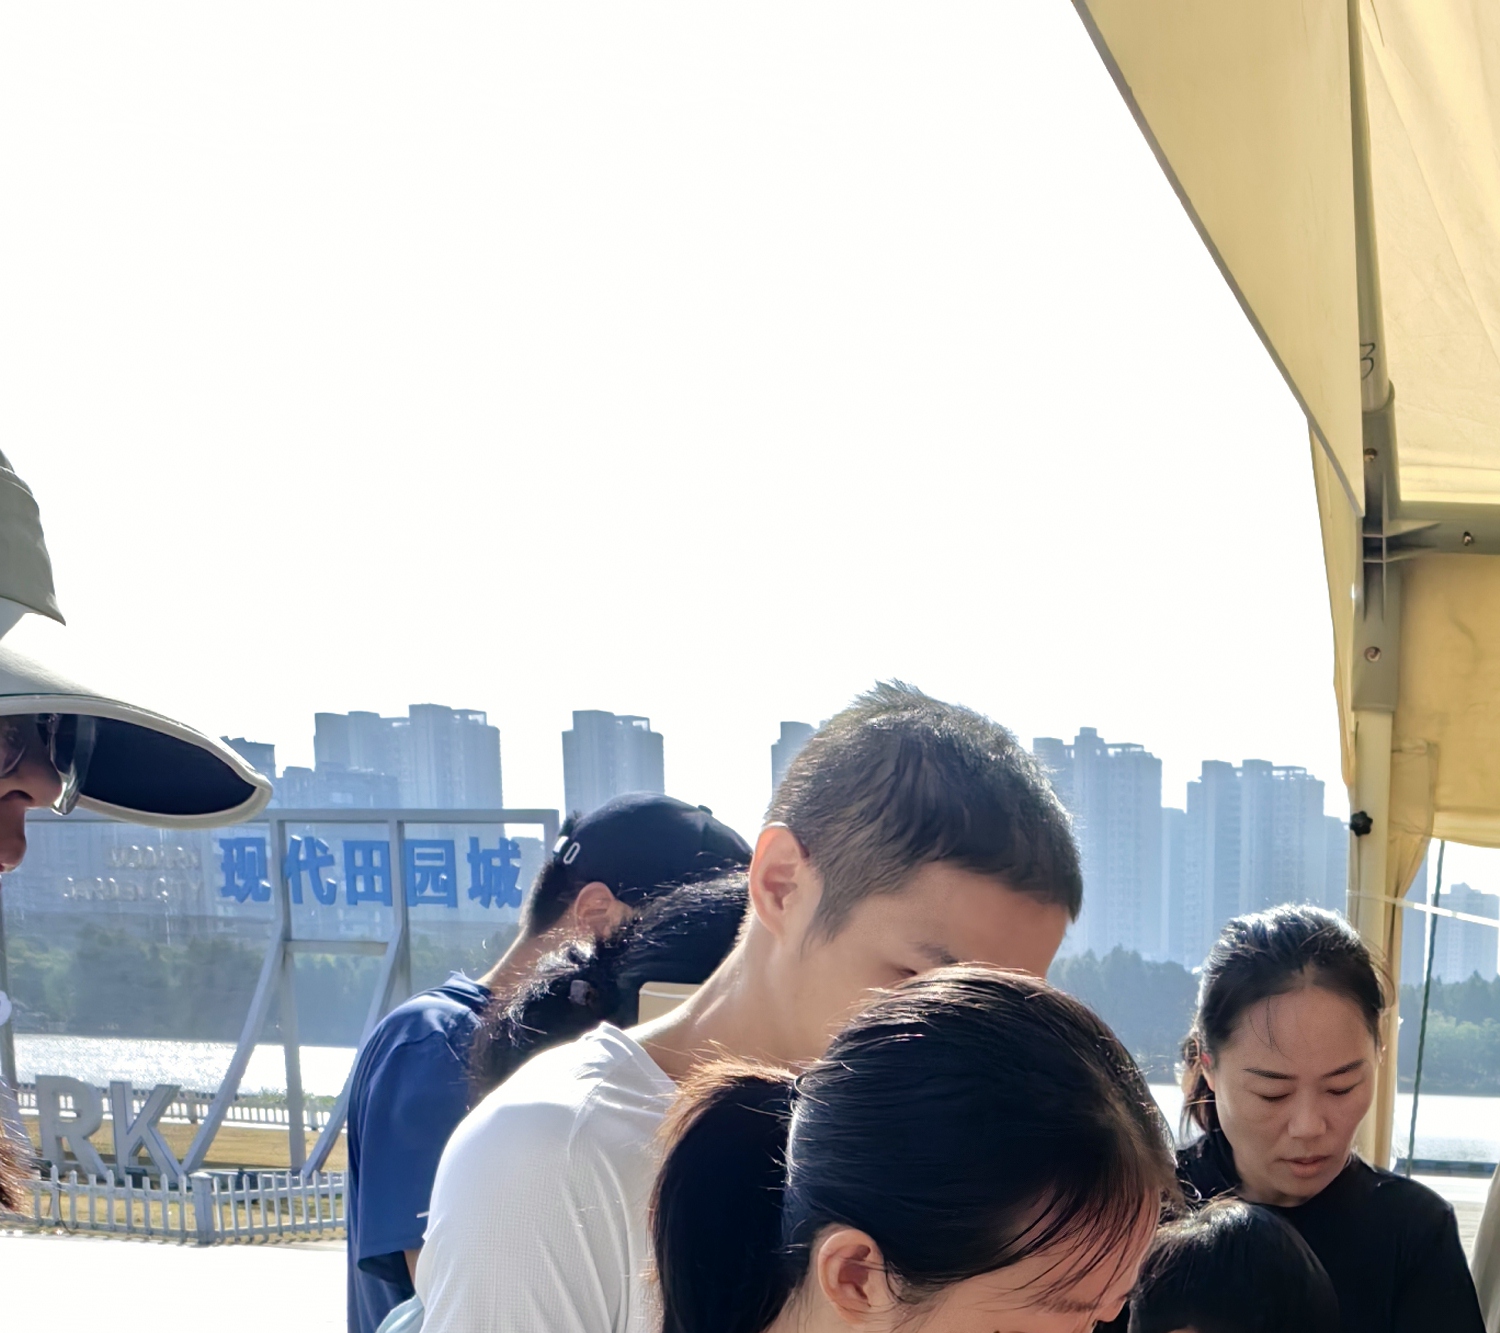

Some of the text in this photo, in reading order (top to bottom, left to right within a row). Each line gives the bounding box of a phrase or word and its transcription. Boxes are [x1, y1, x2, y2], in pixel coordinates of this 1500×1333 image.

[219, 835, 522, 908] 现代田园城
